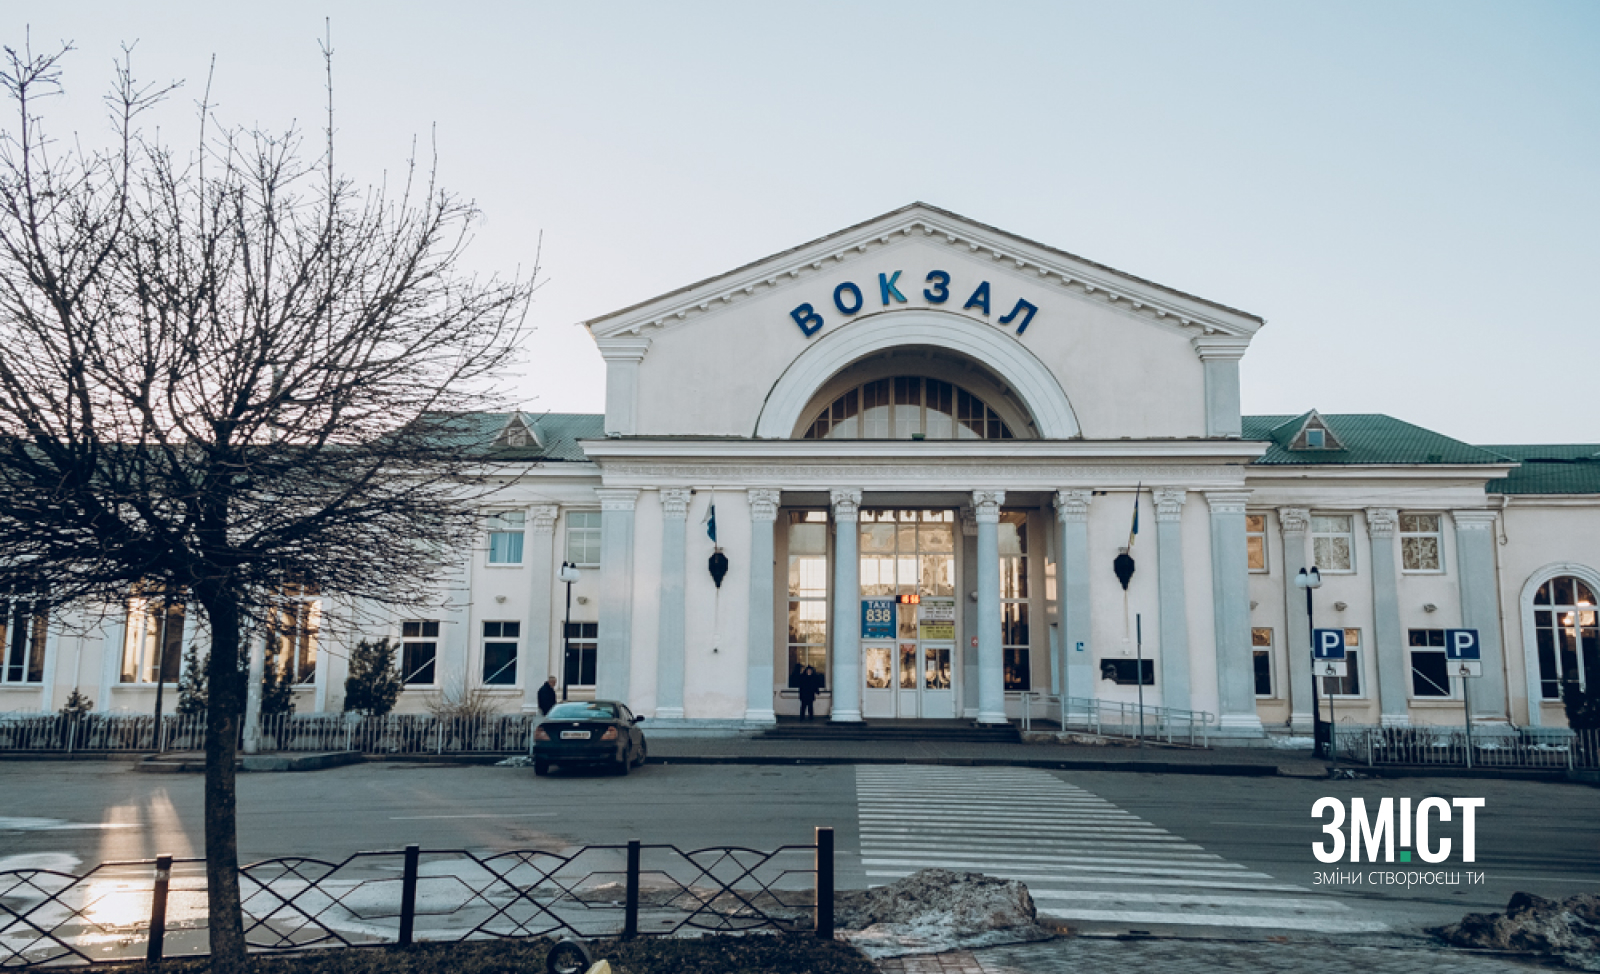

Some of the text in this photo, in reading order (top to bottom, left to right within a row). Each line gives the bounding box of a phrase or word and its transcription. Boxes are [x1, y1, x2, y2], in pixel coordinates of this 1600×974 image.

[790, 270, 1039, 338] ВОКЗАЛ
[866, 609, 892, 622] 838
[1321, 631, 1340, 656] P
[1454, 631, 1474, 657] P
